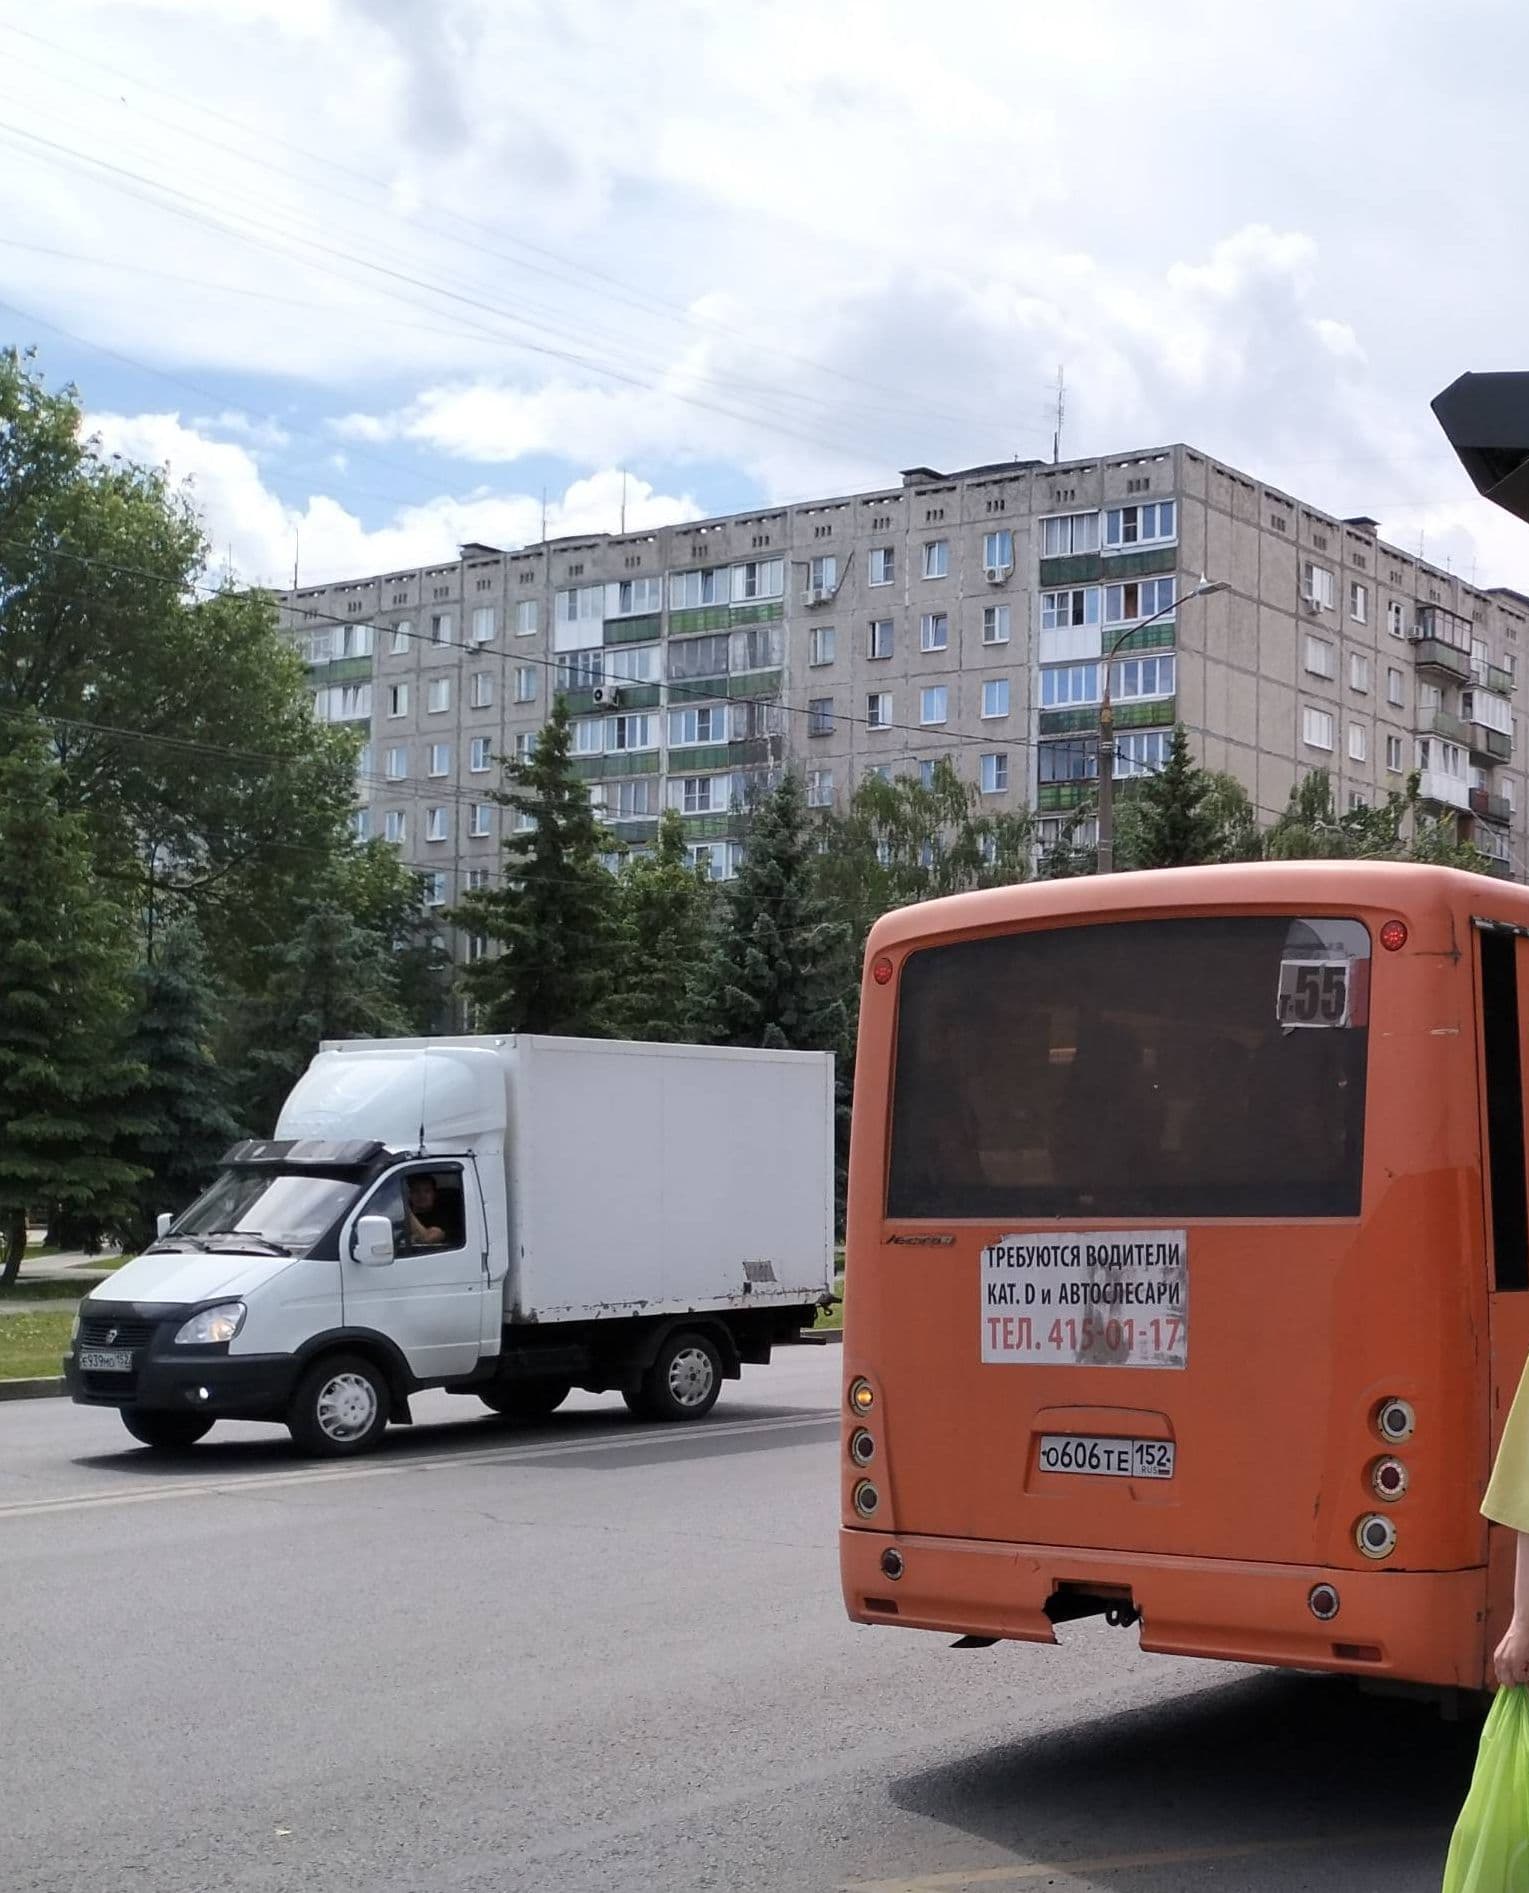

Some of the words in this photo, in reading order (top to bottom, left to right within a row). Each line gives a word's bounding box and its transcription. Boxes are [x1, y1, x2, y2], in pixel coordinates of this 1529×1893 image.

[987, 1244, 1080, 1268] ТРЕБУЮТСЯ
[1086, 1243, 1180, 1270] ВОДИТЕЛИ
[988, 1282, 1020, 1305] КАТ.
[1025, 1282, 1035, 1304] D
[1041, 1289, 1051, 1304] и
[1058, 1282, 1180, 1305] АВТОСЛЕСАРИ
[987, 1317, 1041, 1351] ТЕЛ.
[1048, 1317, 1180, 1352] 415-01-17
[1136, 1444, 1167, 1467] 152
[1142, 1465, 1158, 1474] RUS
